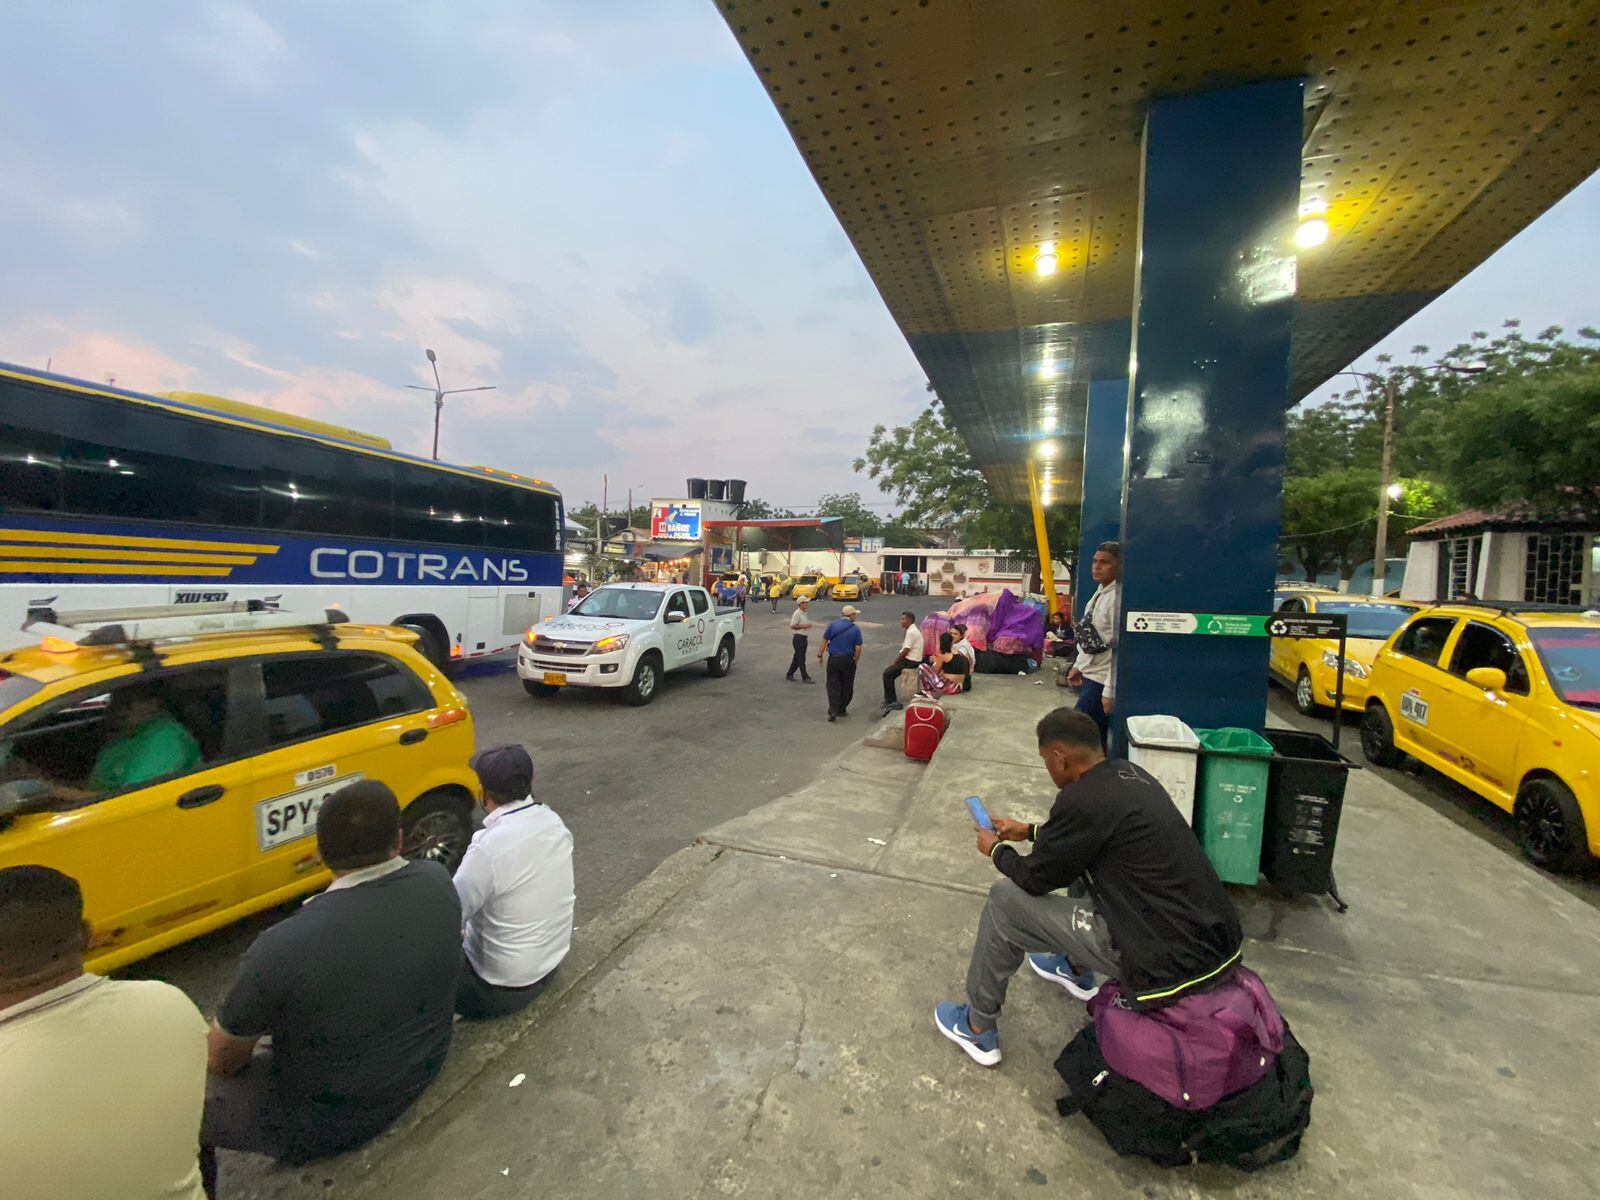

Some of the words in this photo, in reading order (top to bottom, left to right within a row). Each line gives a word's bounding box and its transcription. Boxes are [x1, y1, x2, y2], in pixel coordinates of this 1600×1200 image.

[310, 547, 528, 581] COTRANS
[677, 634, 704, 651] CARACOL
[266, 799, 314, 835] SPY
